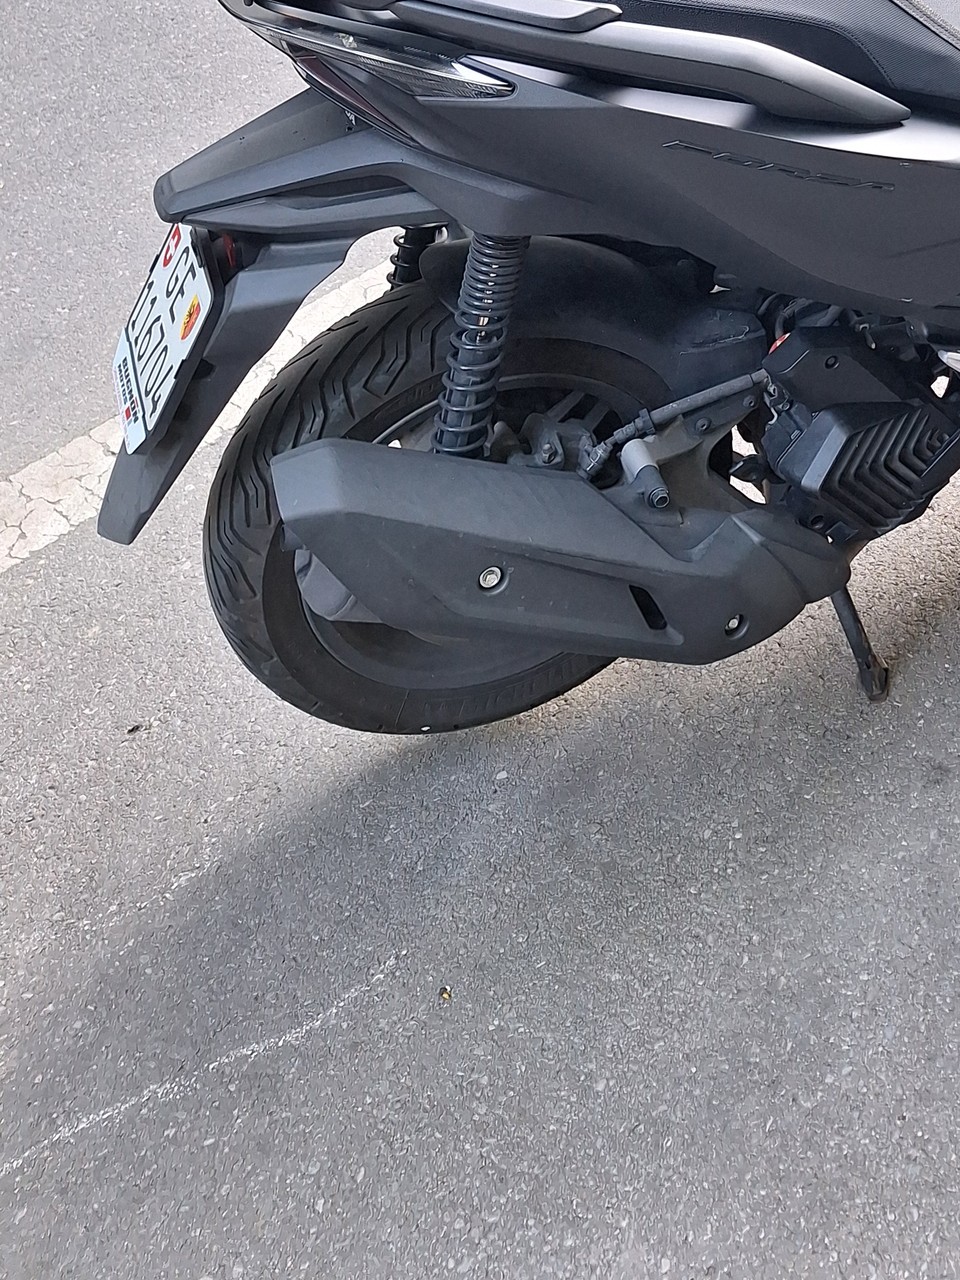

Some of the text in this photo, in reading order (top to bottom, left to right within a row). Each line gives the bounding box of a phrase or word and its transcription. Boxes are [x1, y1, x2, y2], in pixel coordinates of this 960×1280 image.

[165, 245, 196, 324] GE
[117, 364, 128, 406] MOTOS
[131, 280, 173, 420] 116704
